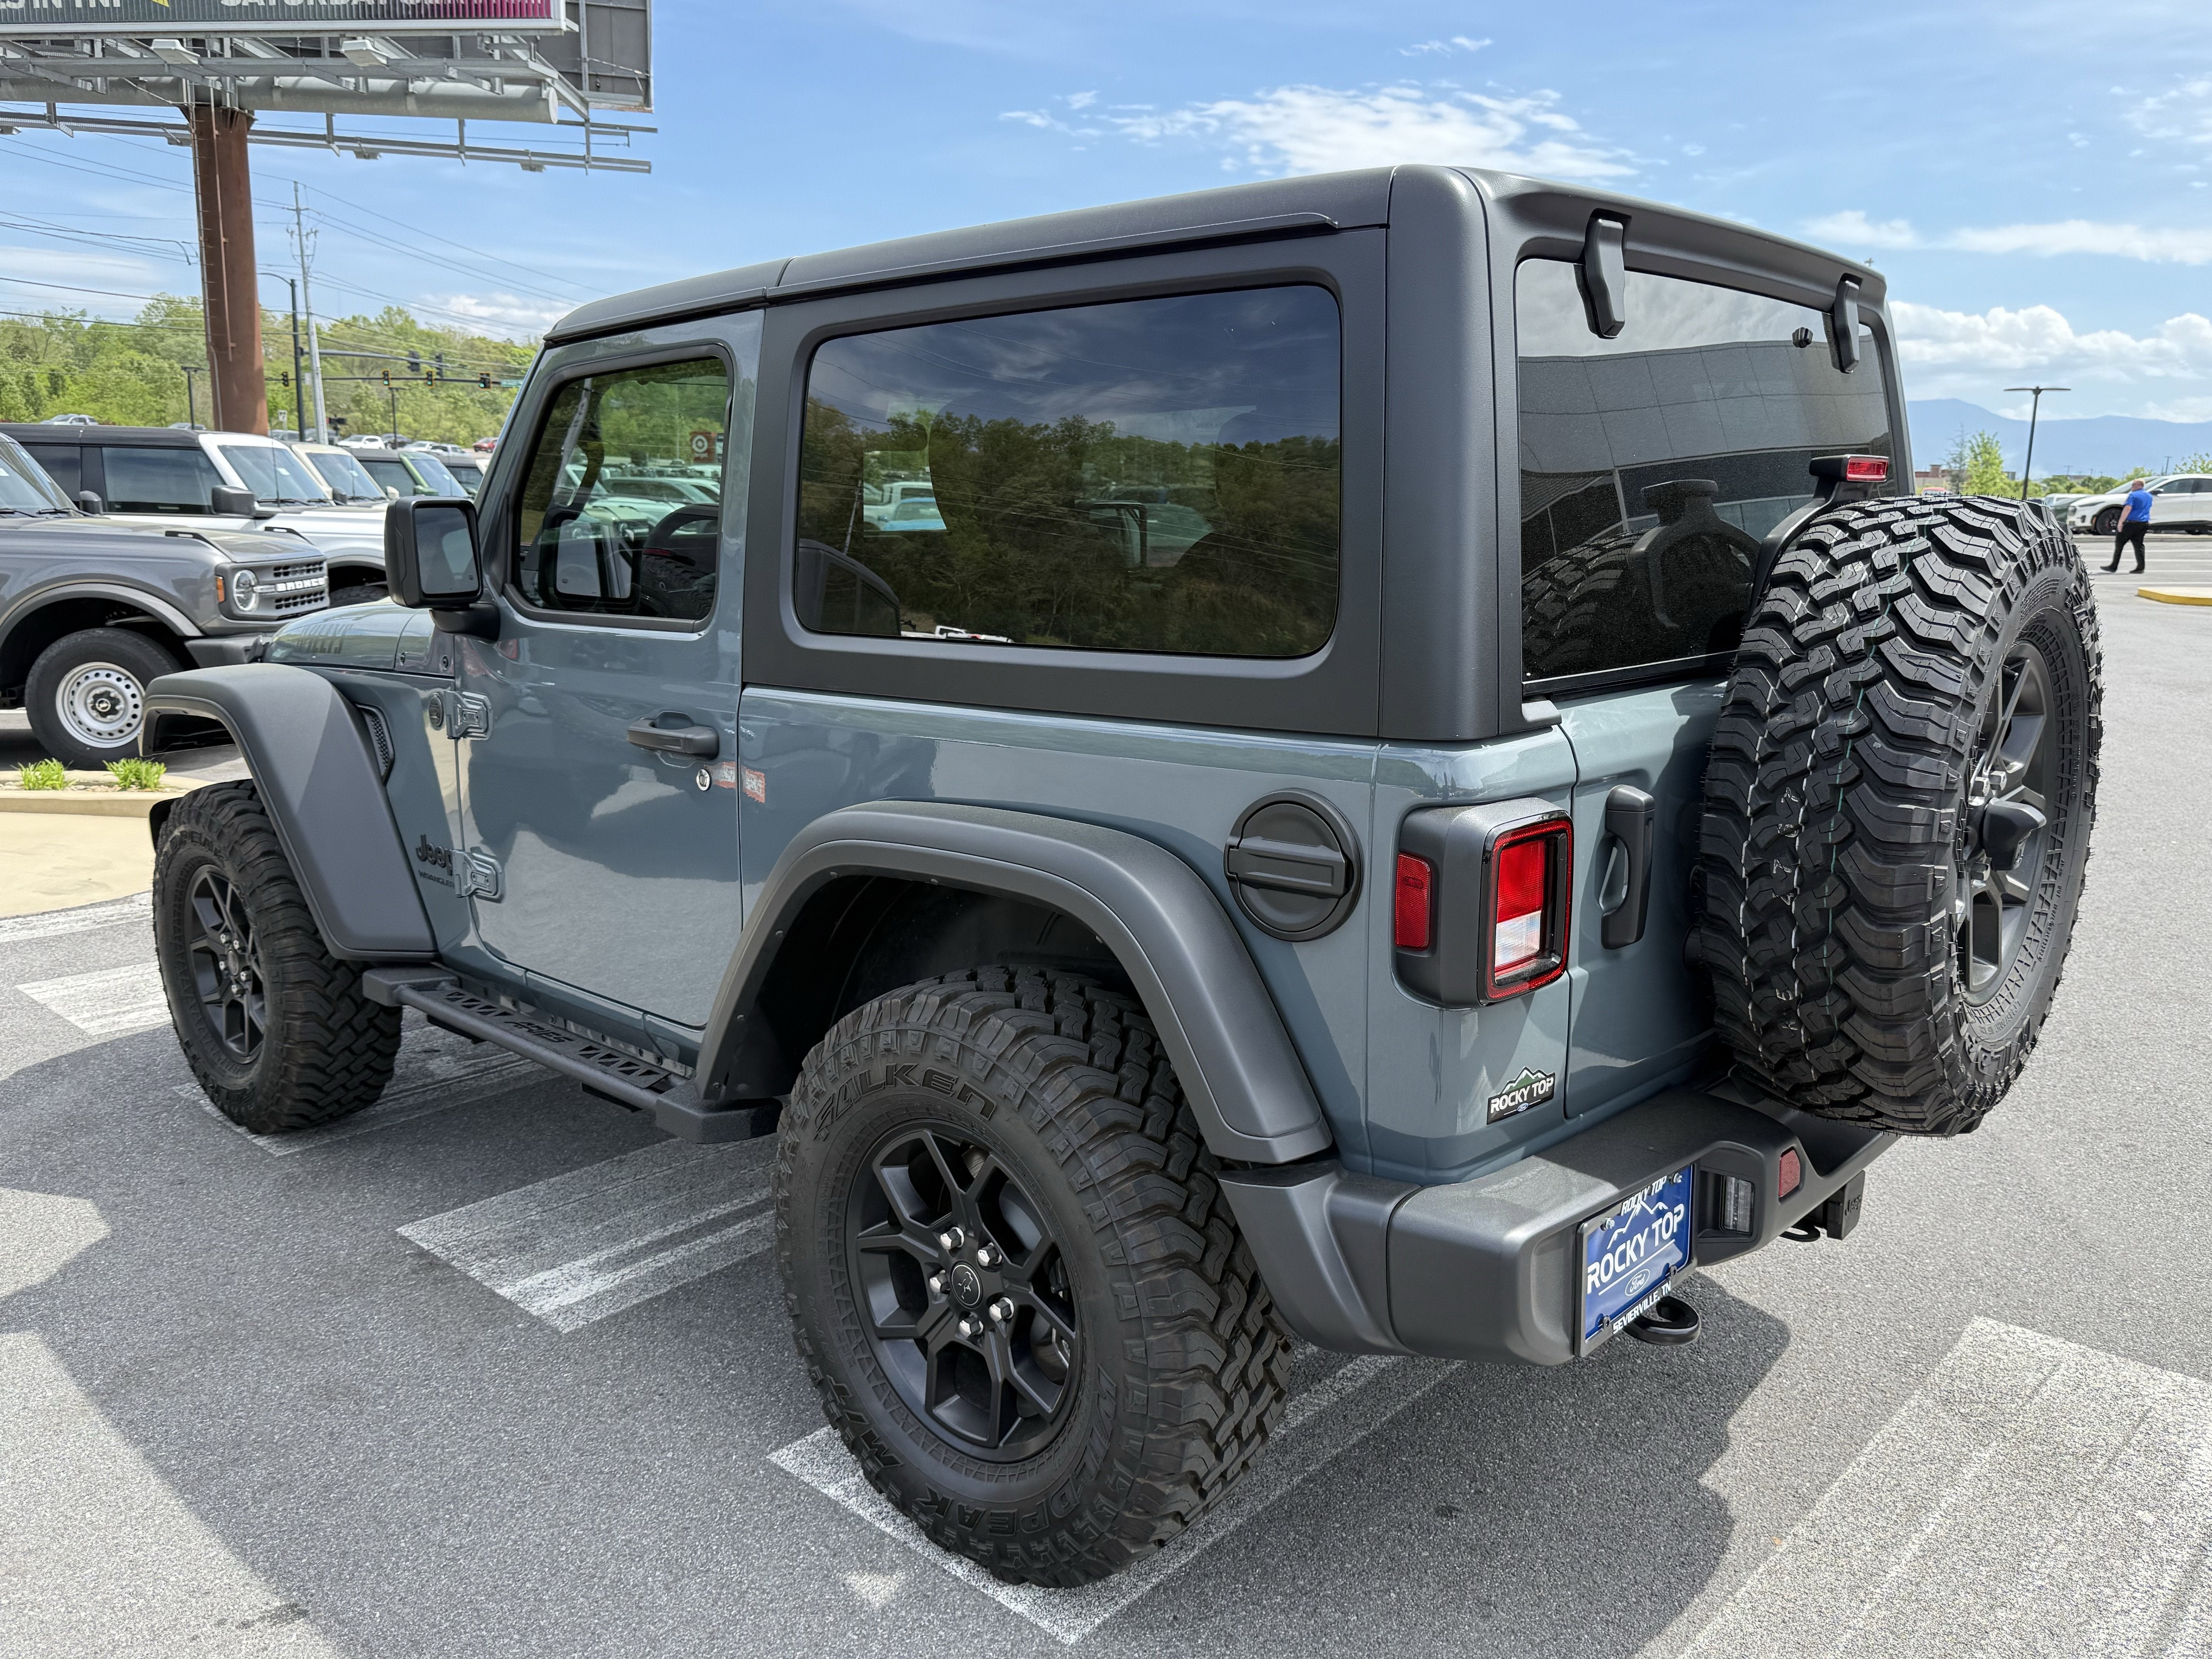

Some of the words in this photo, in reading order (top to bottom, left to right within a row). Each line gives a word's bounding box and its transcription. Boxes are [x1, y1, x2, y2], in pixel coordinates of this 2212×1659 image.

[276, 577, 325, 592] BRONCO
[416, 834, 453, 876] Jeep
[418, 870, 455, 889] WRANGLER
[814, 1063, 998, 1142] FALKEN
[1491, 1085, 1531, 1113] ROCKY
[1532, 1077, 1554, 1097] TOP
[1621, 1185, 1650, 1216] ROCKY
[1651, 1175, 1667, 1195] TOP
[1587, 1226, 1649, 1294] ROCKY
[1652, 1203, 1685, 1247] TOP
[1629, 1273, 1646, 1292] Ford
[1613, 1291, 1660, 1335] SEVIERVILLE,
[1661, 1281, 1672, 1296] TN
[913, 1363, 1117, 1537] WILDPEAK
